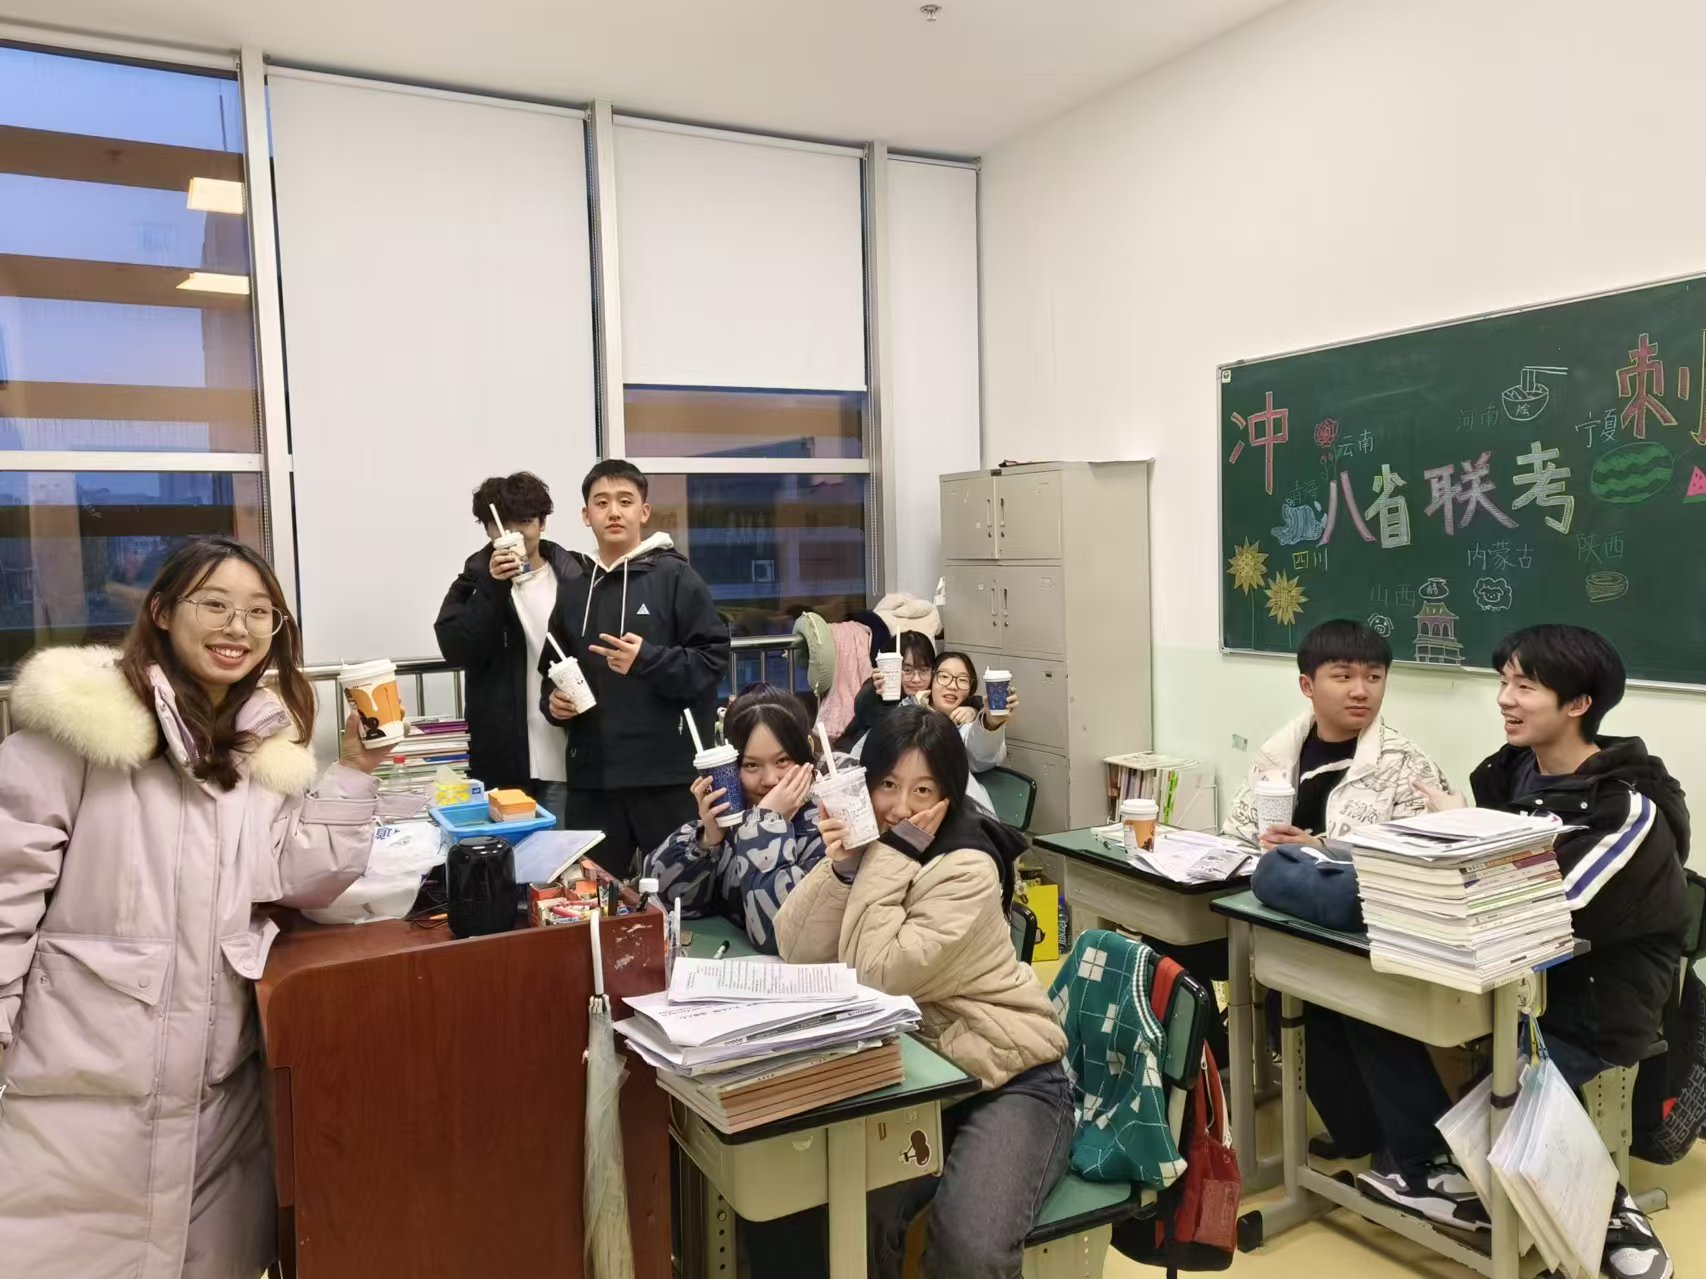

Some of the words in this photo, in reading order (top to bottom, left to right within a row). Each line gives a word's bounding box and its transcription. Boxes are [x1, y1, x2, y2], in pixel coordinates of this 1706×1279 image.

[1616, 329, 1706, 446] 刺
[1456, 403, 1499, 432] 河南
[1575, 408, 1617, 448] 宁夏
[1229, 391, 1289, 496] 冲
[1338, 429, 1374, 457] 云南
[1316, 440, 1575, 549] 八省联考
[1292, 548, 1328, 571] 四川
[1467, 541, 1534, 571] 内蒙古
[1575, 531, 1624, 563] 陕西
[1369, 584, 1416, 608] 山西
